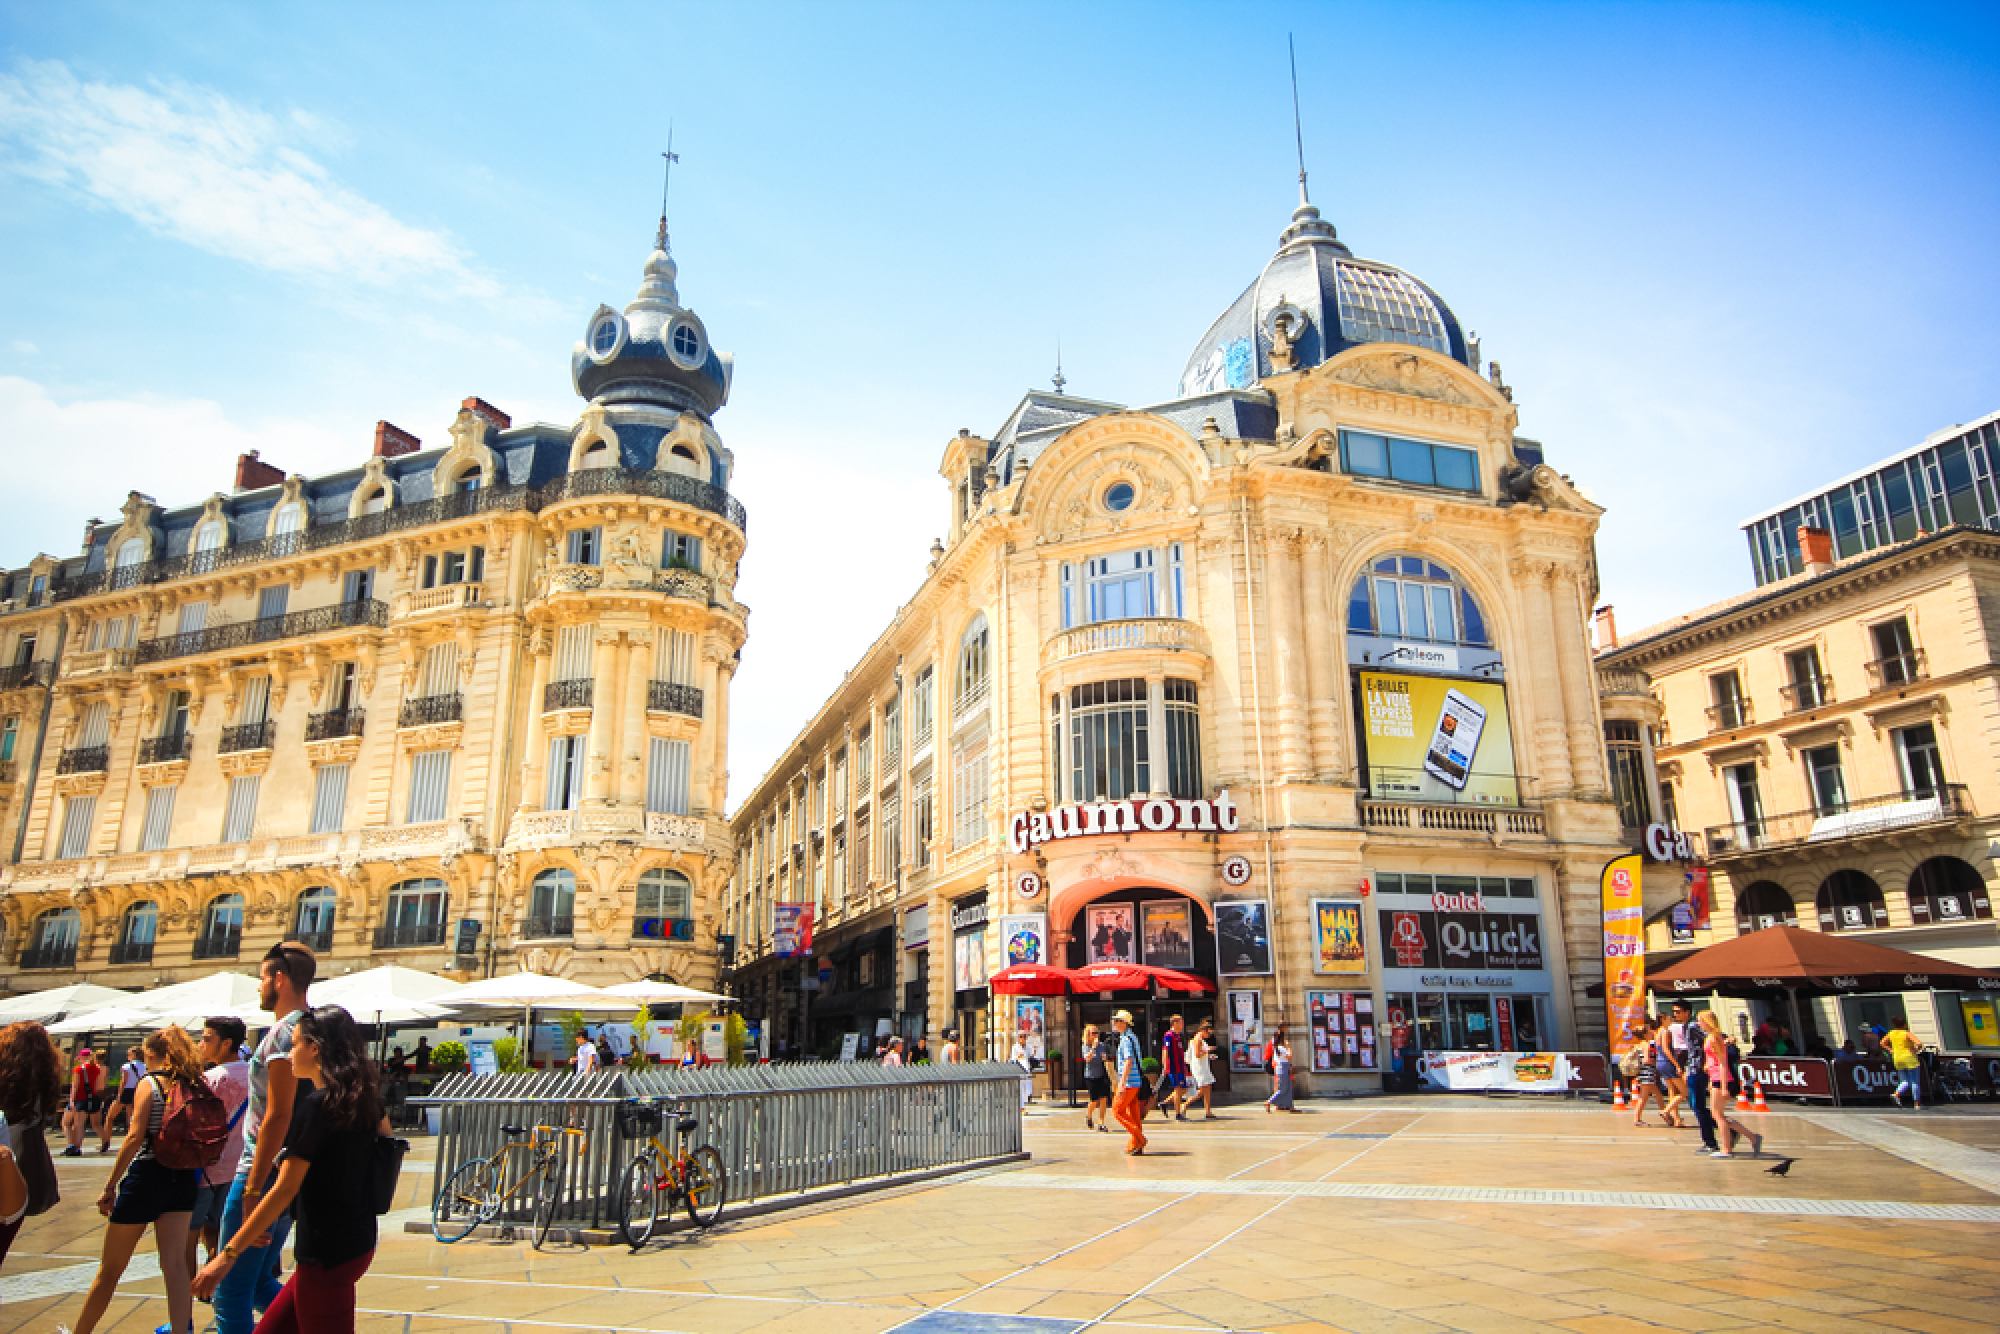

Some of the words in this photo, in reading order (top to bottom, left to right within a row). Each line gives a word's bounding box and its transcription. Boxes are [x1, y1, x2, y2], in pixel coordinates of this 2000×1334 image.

[1009, 789, 1239, 855] Gaumont
[1228, 863, 1246, 879] G
[1021, 877, 1035, 893] G
[1432, 891, 1487, 912] Quick
[1320, 909, 1359, 928] MAD
[642, 919, 690, 940] CIC
[1321, 928, 1360, 949] MAX
[1441, 922, 1539, 958] Quick
[1738, 1062, 1809, 1092] Quick
[1852, 1064, 1900, 1092] Quic
